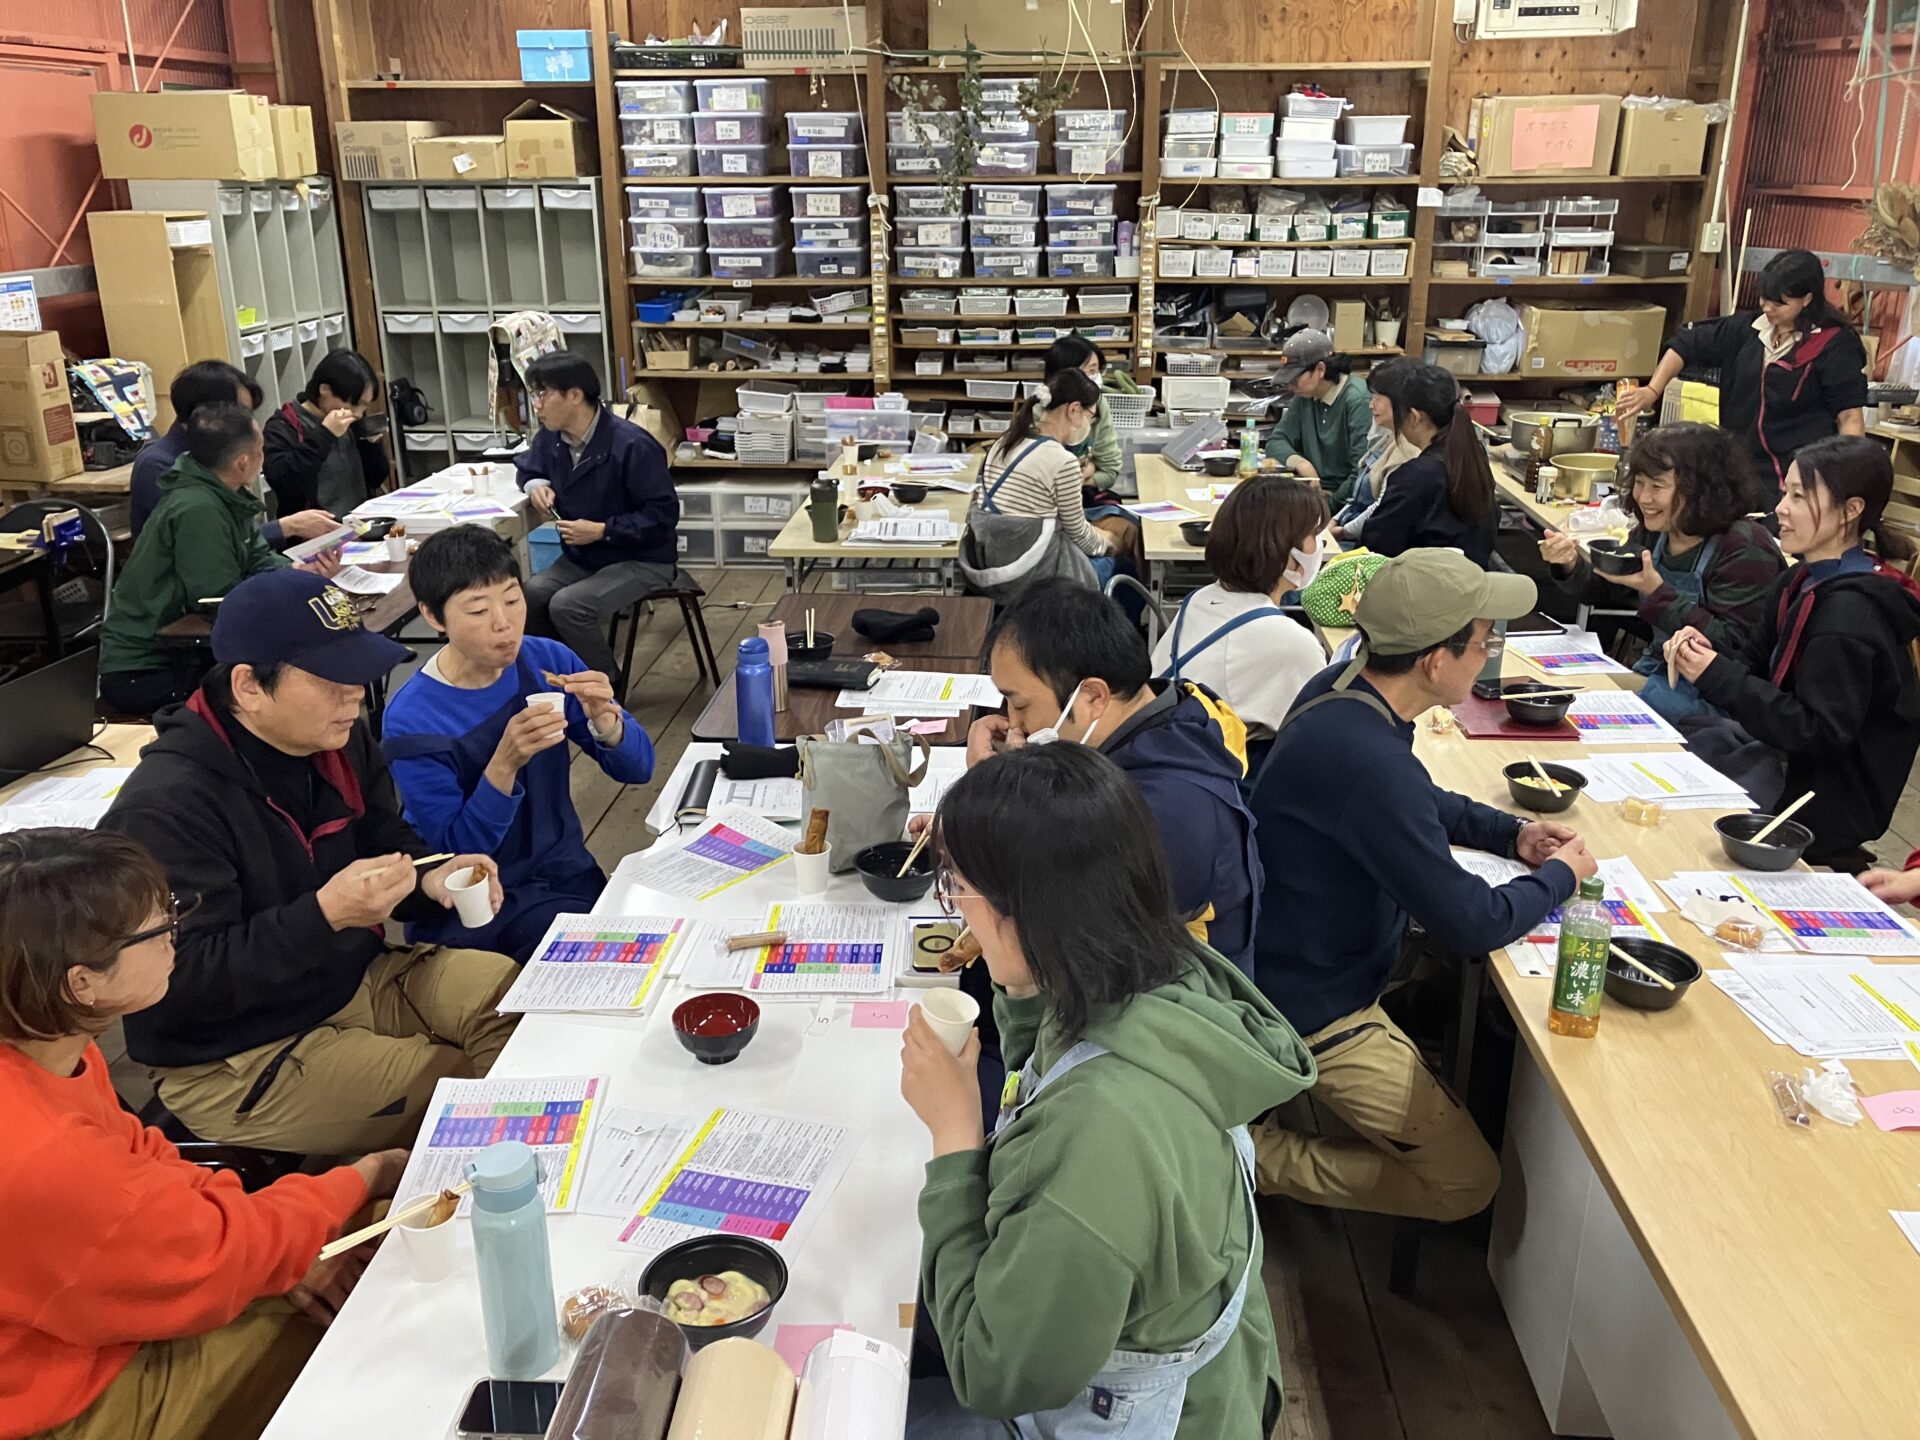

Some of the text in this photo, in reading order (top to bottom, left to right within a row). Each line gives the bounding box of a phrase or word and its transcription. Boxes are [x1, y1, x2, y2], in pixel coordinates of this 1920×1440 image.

[1576, 941, 1592, 959] 茶
[1566, 960, 1590, 1007] 濃い味
[1588, 964, 1602, 995] 伊右衛門
